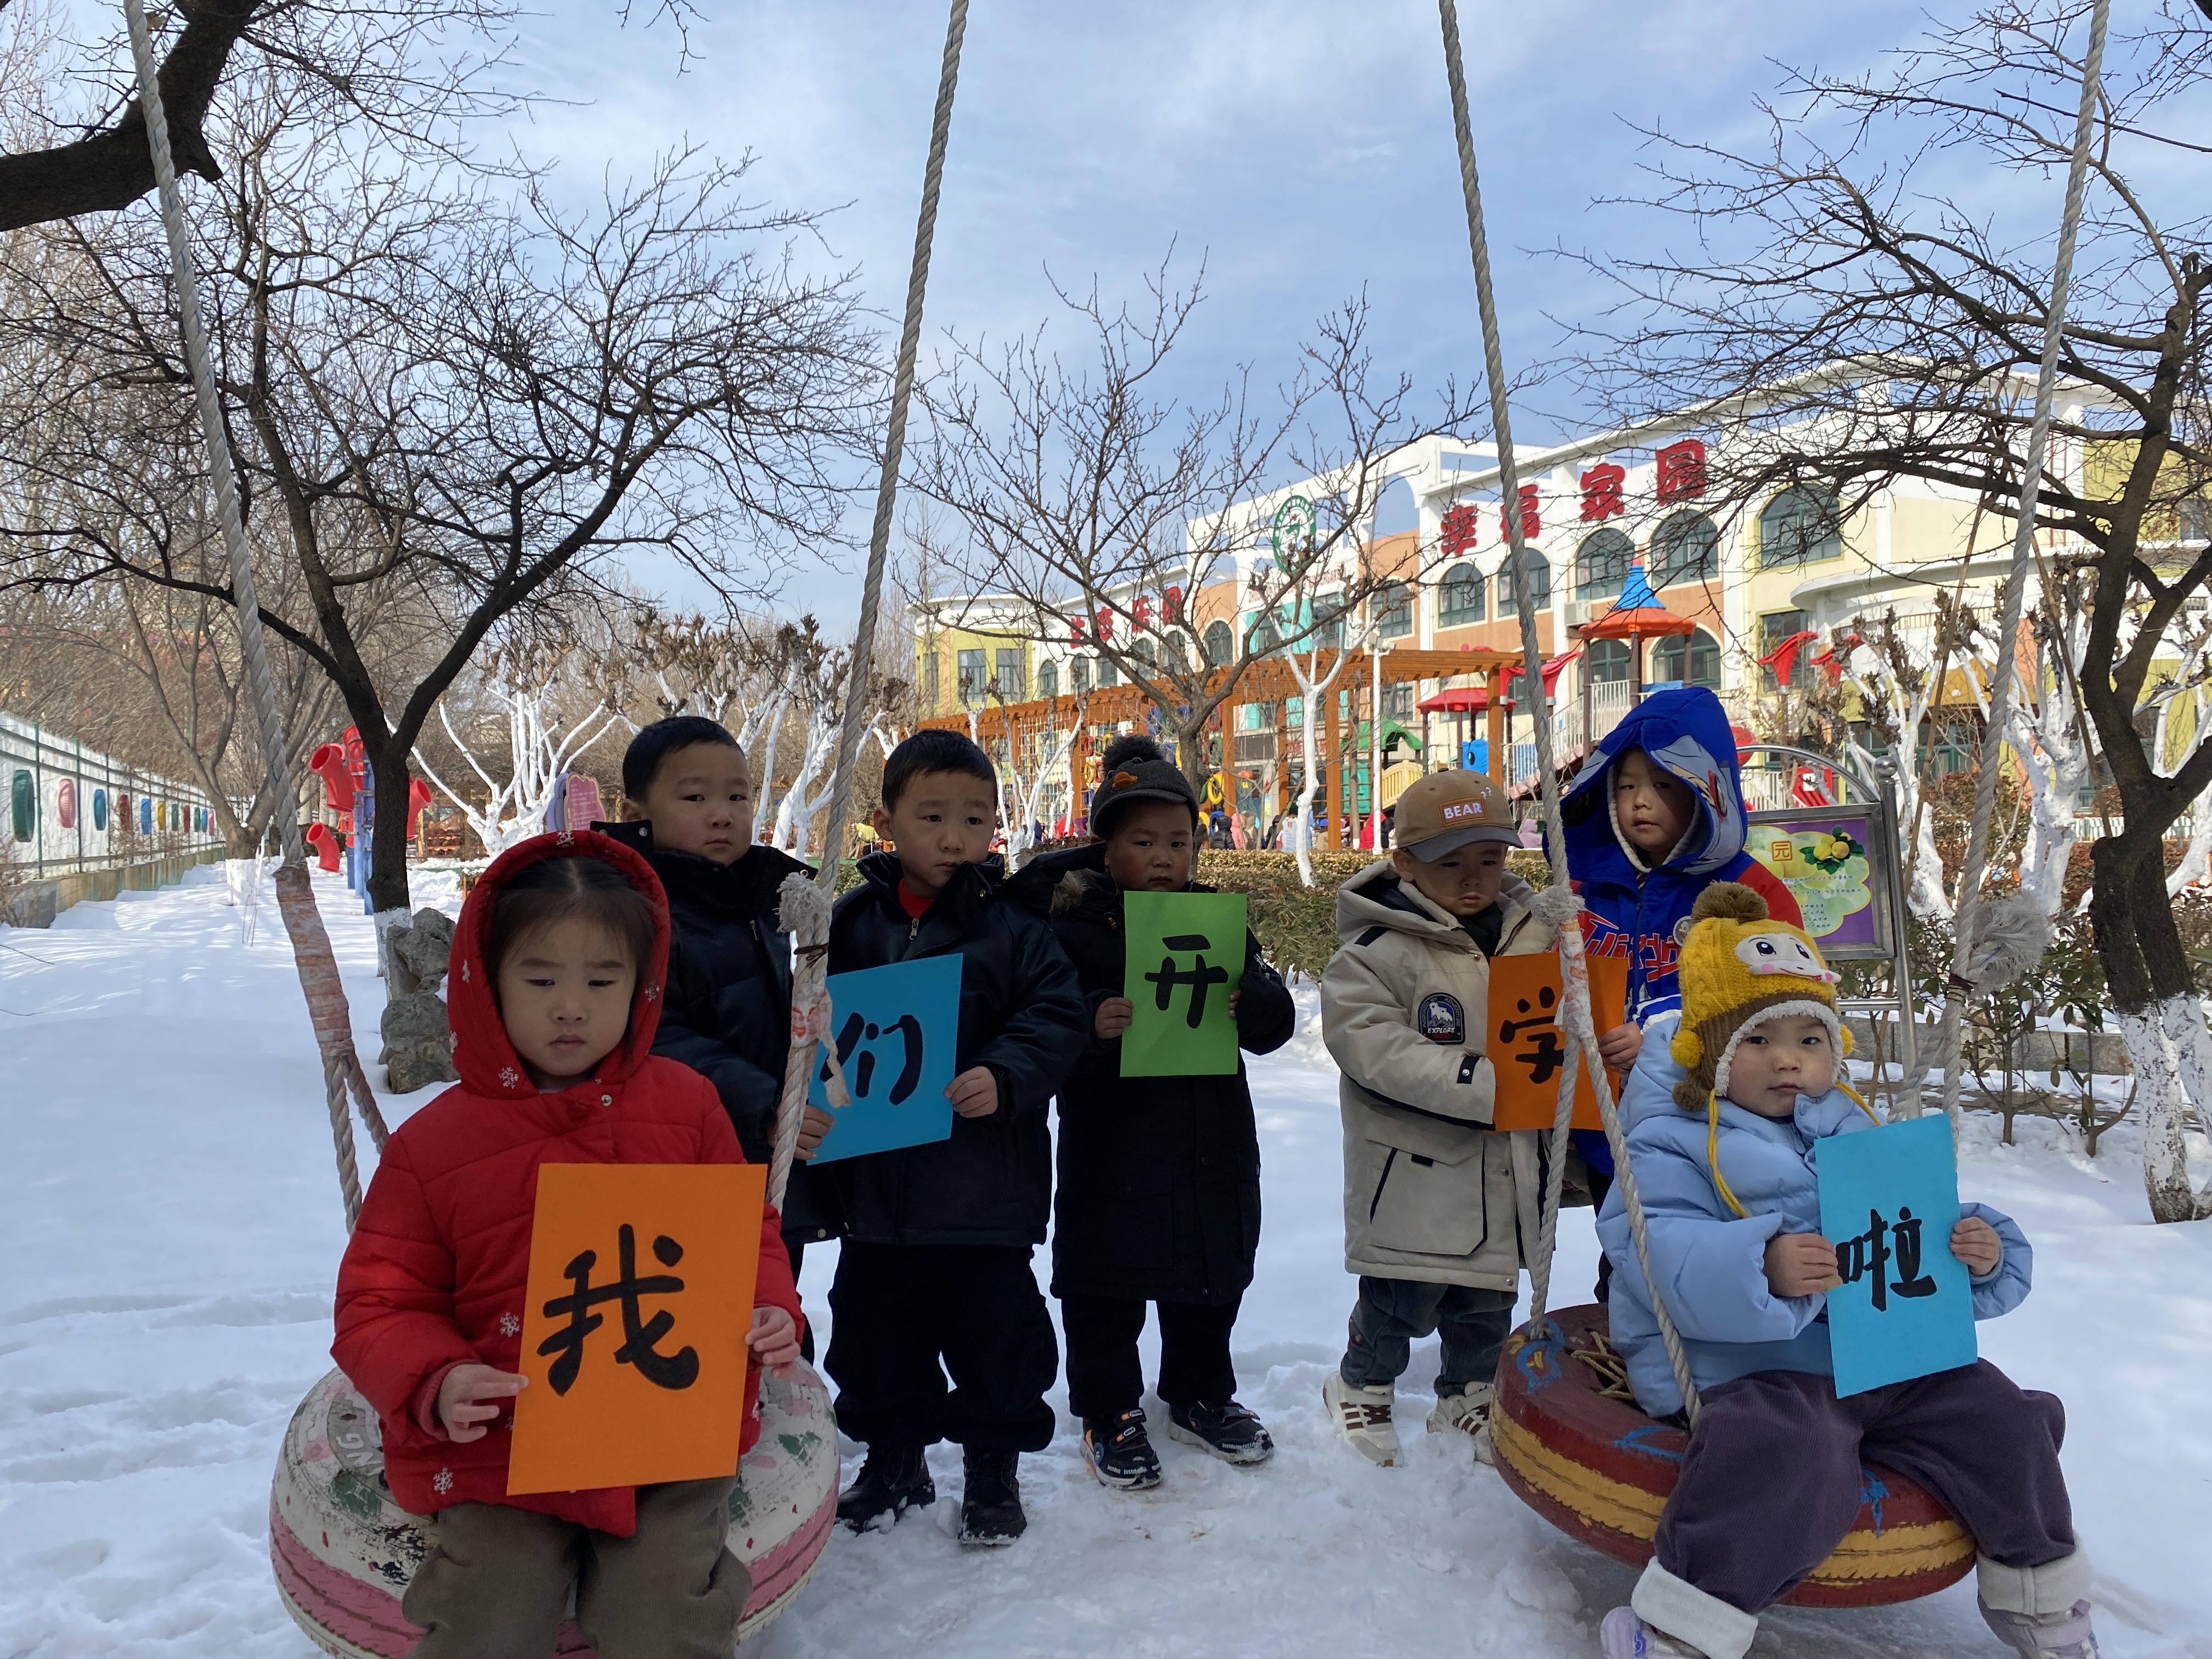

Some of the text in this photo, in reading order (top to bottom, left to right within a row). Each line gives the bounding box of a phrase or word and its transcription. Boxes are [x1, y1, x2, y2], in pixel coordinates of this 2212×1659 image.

[1444, 803, 1483, 819] BEAR
[1144, 934, 1229, 1029] 开
[819, 1012, 923, 1105] 们
[1499, 986, 1565, 1084] 学
[1836, 1206, 1937, 1312] 啦
[537, 1223, 699, 1397] 我
